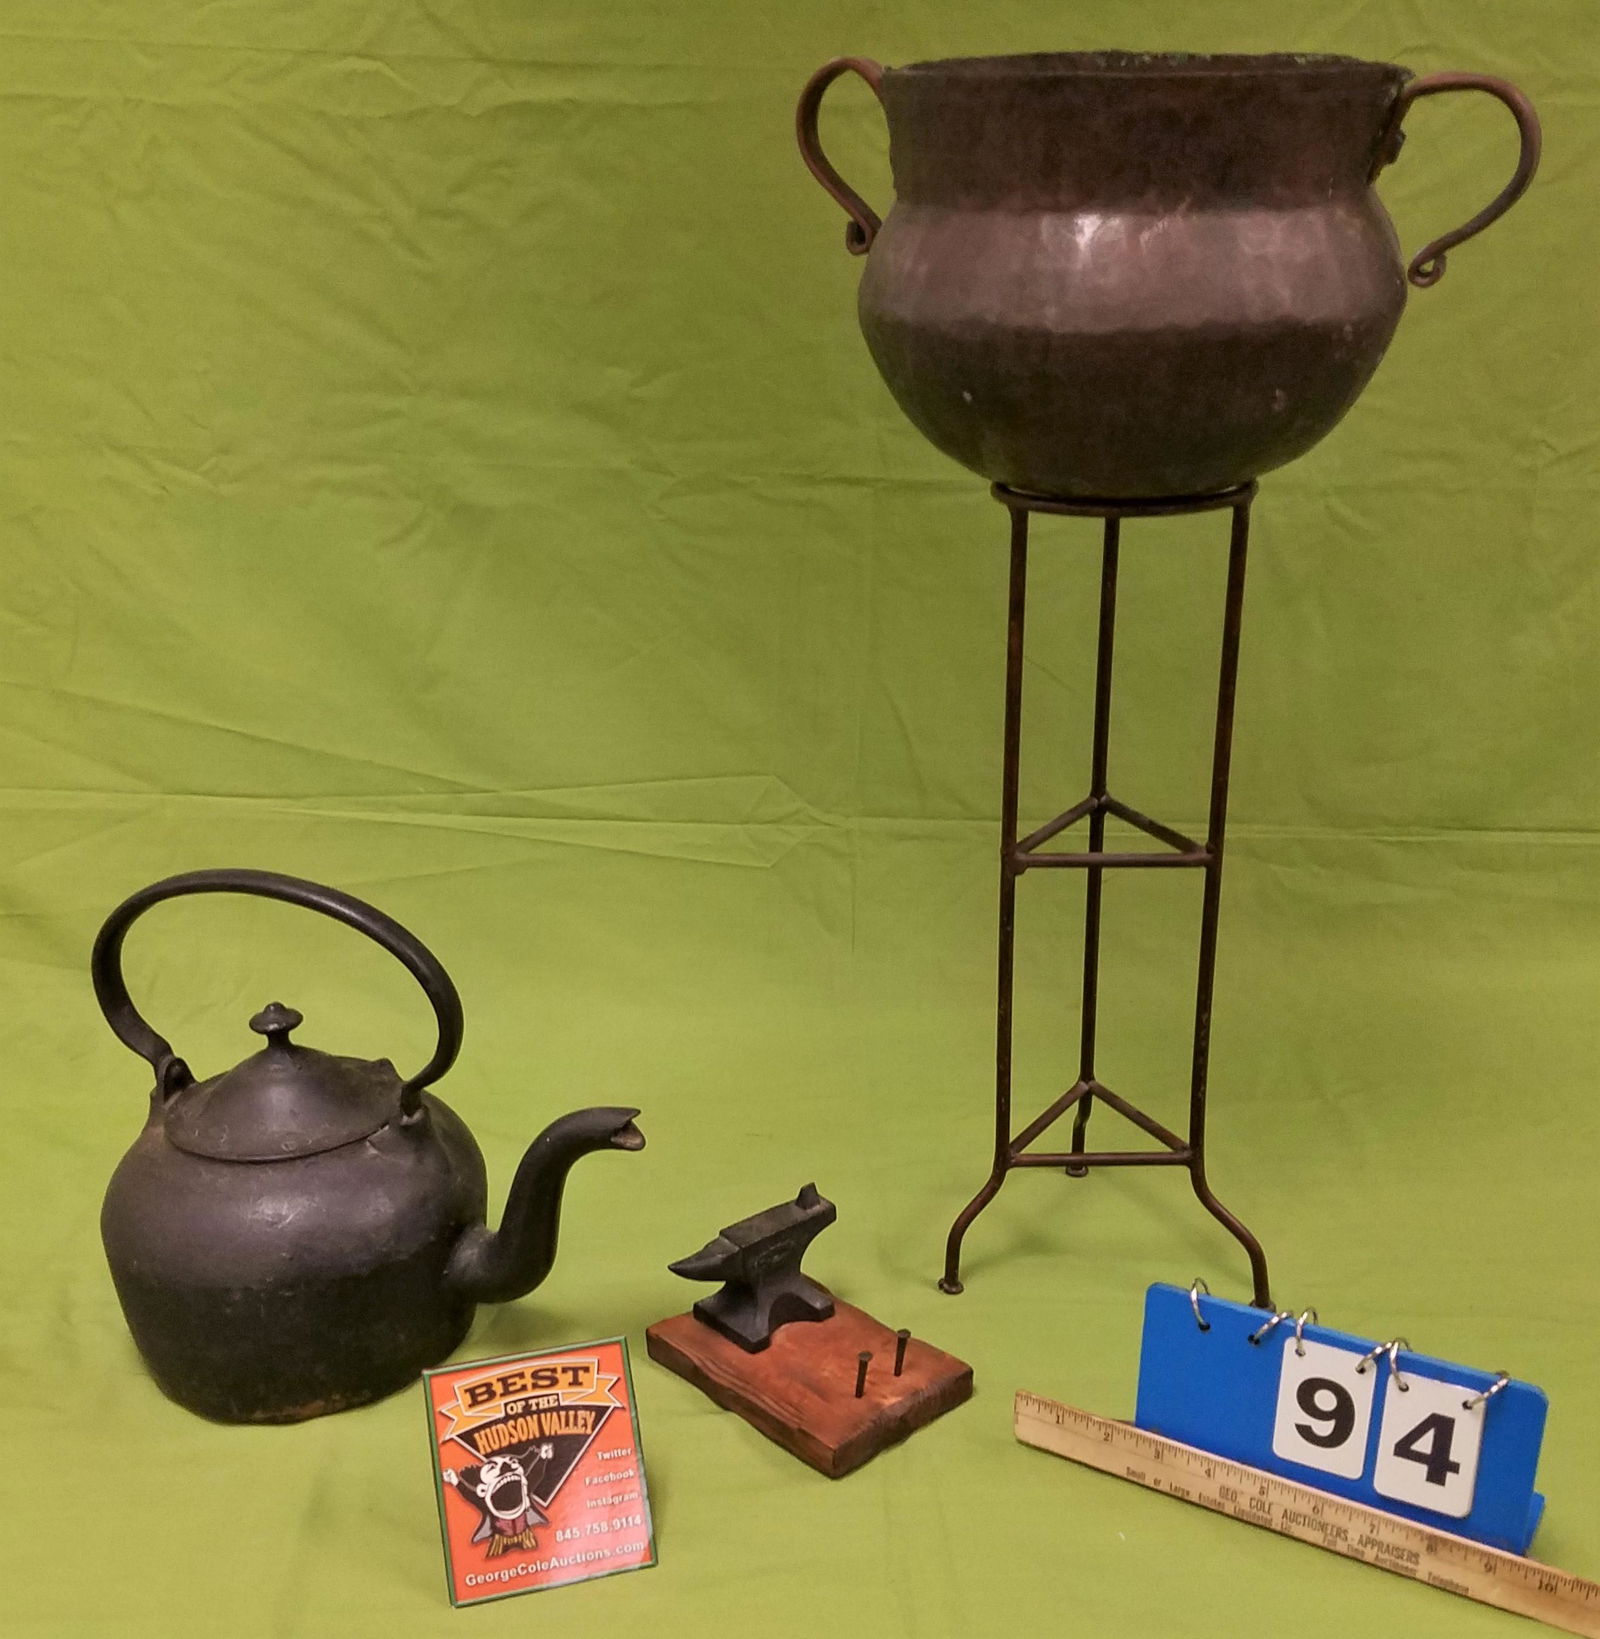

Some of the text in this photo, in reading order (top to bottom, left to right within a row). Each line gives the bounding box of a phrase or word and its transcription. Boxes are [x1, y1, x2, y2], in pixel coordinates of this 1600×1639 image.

[463, 1366, 590, 1408] BEST
[506, 1395, 559, 1415] OF THE
[473, 1410, 596, 1456] HUDSON VALLEY
[1294, 1377, 1460, 1487] 9 4
[596, 1447, 633, 1461] Twitter
[584, 1468, 635, 1486] Facebook
[586, 1491, 639, 1509] Instagram
[1103, 1431, 1110, 1442] 2
[1204, 1467, 1212, 1478] 4
[1312, 1504, 1320, 1515] 6
[1369, 1522, 1377, 1534] 7
[1483, 1560, 1493, 1573] 9
[1537, 1578, 1554, 1594] 10
[555, 1514, 642, 1542] 845.758.9114
[1281, 1508, 1349, 1542] AUCTIONEERS
[1357, 1534, 1420, 1566] APPRAISERS
[465, 1540, 645, 1587] GeorgeColeAuctions.com
